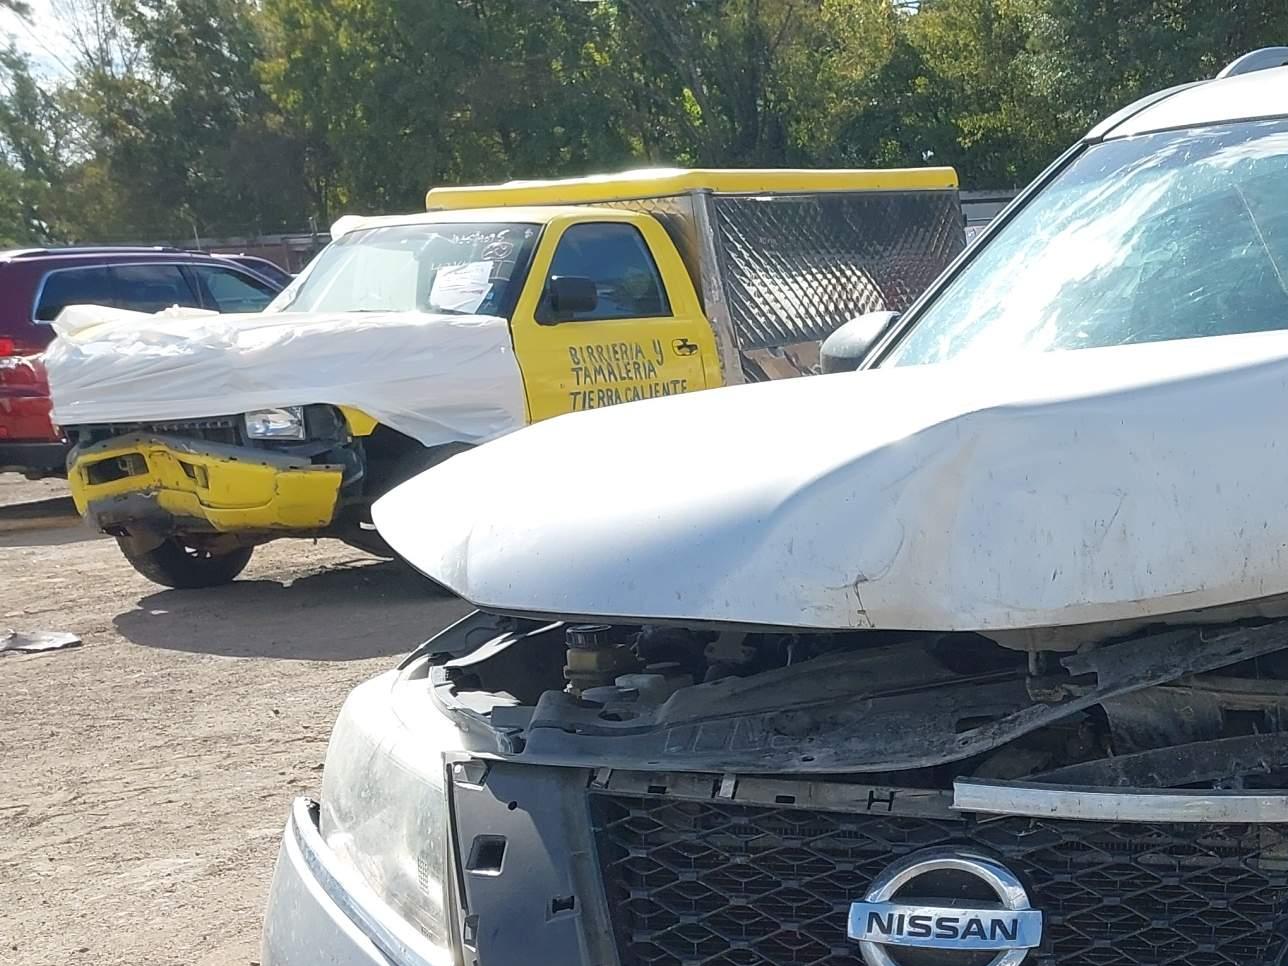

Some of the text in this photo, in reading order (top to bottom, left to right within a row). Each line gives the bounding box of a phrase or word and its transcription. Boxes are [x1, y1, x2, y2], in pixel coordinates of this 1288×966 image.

[569, 342, 646, 366] BIRRIERIA
[571, 360, 657, 386] TAMALERIA
[569, 379, 687, 411] TIERRA CALIENTE
[866, 911, 1019, 941] NISSAN
